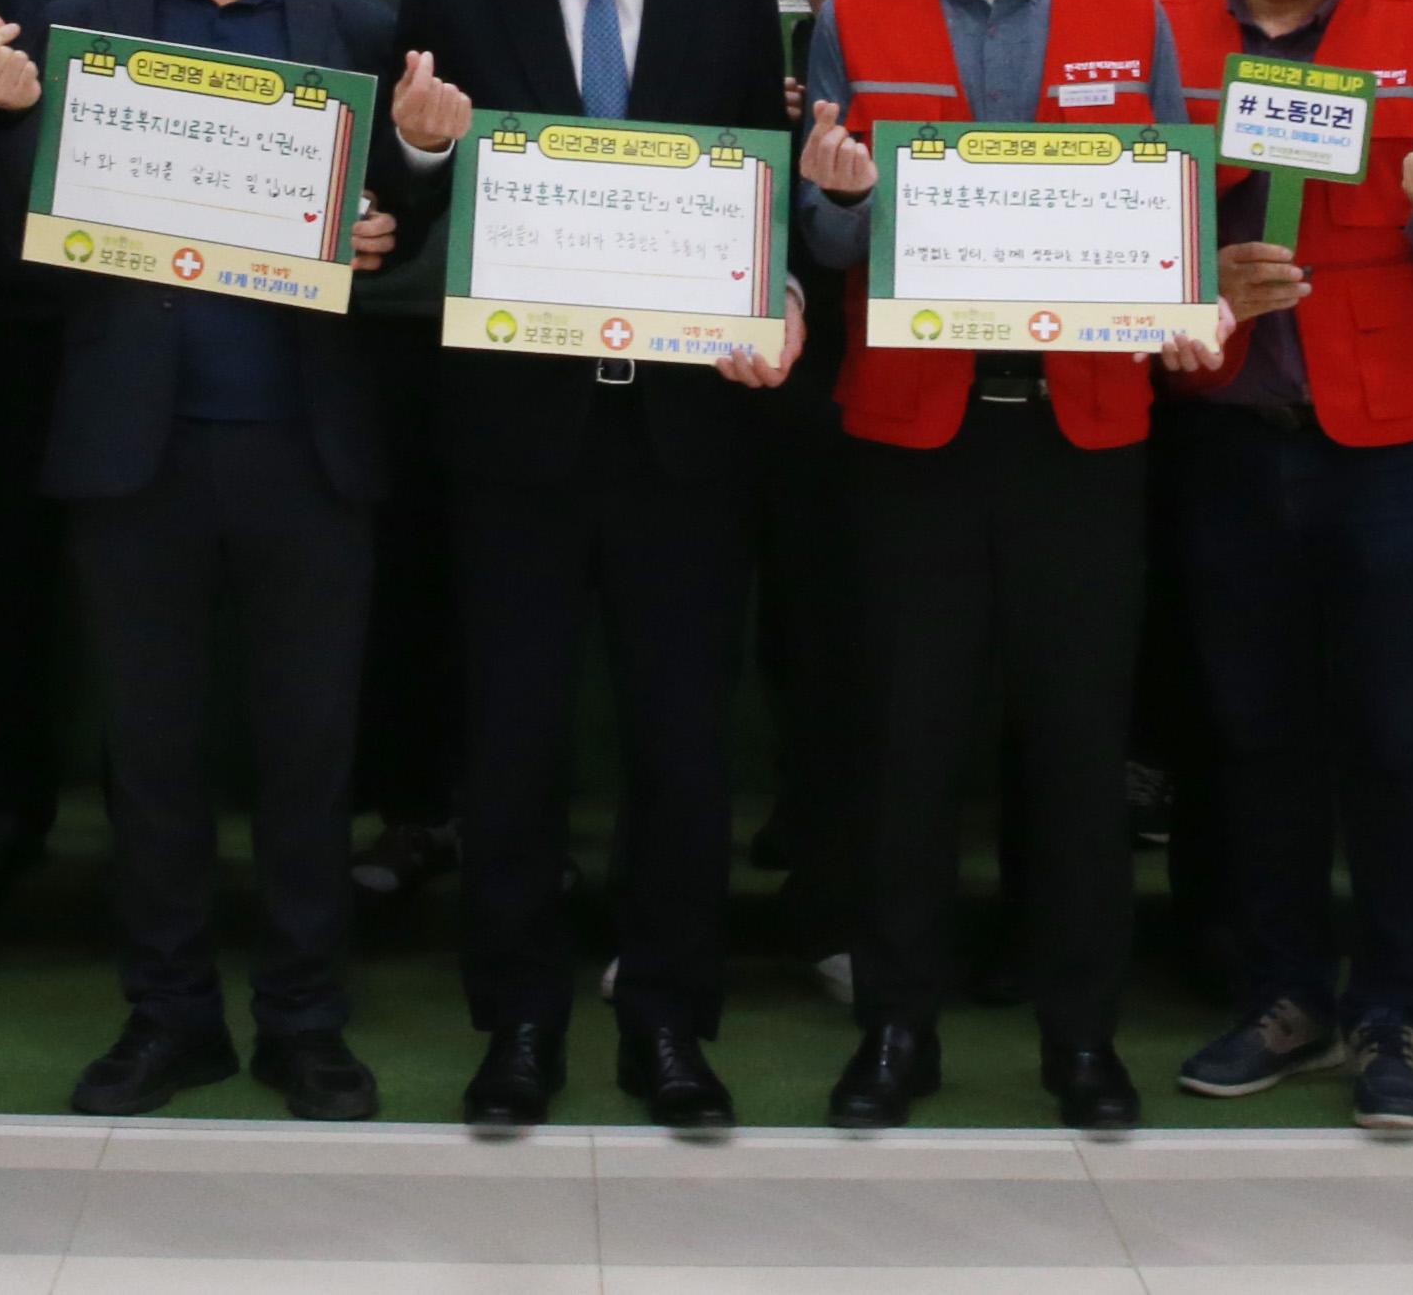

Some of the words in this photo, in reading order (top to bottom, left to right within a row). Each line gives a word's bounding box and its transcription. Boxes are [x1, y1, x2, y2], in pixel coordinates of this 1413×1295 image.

[137, 58, 204, 84] 인권경영
[208, 69, 277, 97] 실천다짐
[1239, 95, 1257, 115] #
[1265, 98, 1354, 130] 노동인권
[548, 132, 616, 155] 인권경영
[622, 137, 691, 160] 실천다짐
[967, 138, 1036, 157] 인권경영
[1044, 140, 1114, 158] 실천다짐
[99, 248, 157, 273] 보훈공단
[524, 326, 584, 347] 보훈공단
[951, 323, 1011, 340] 보훈공단
